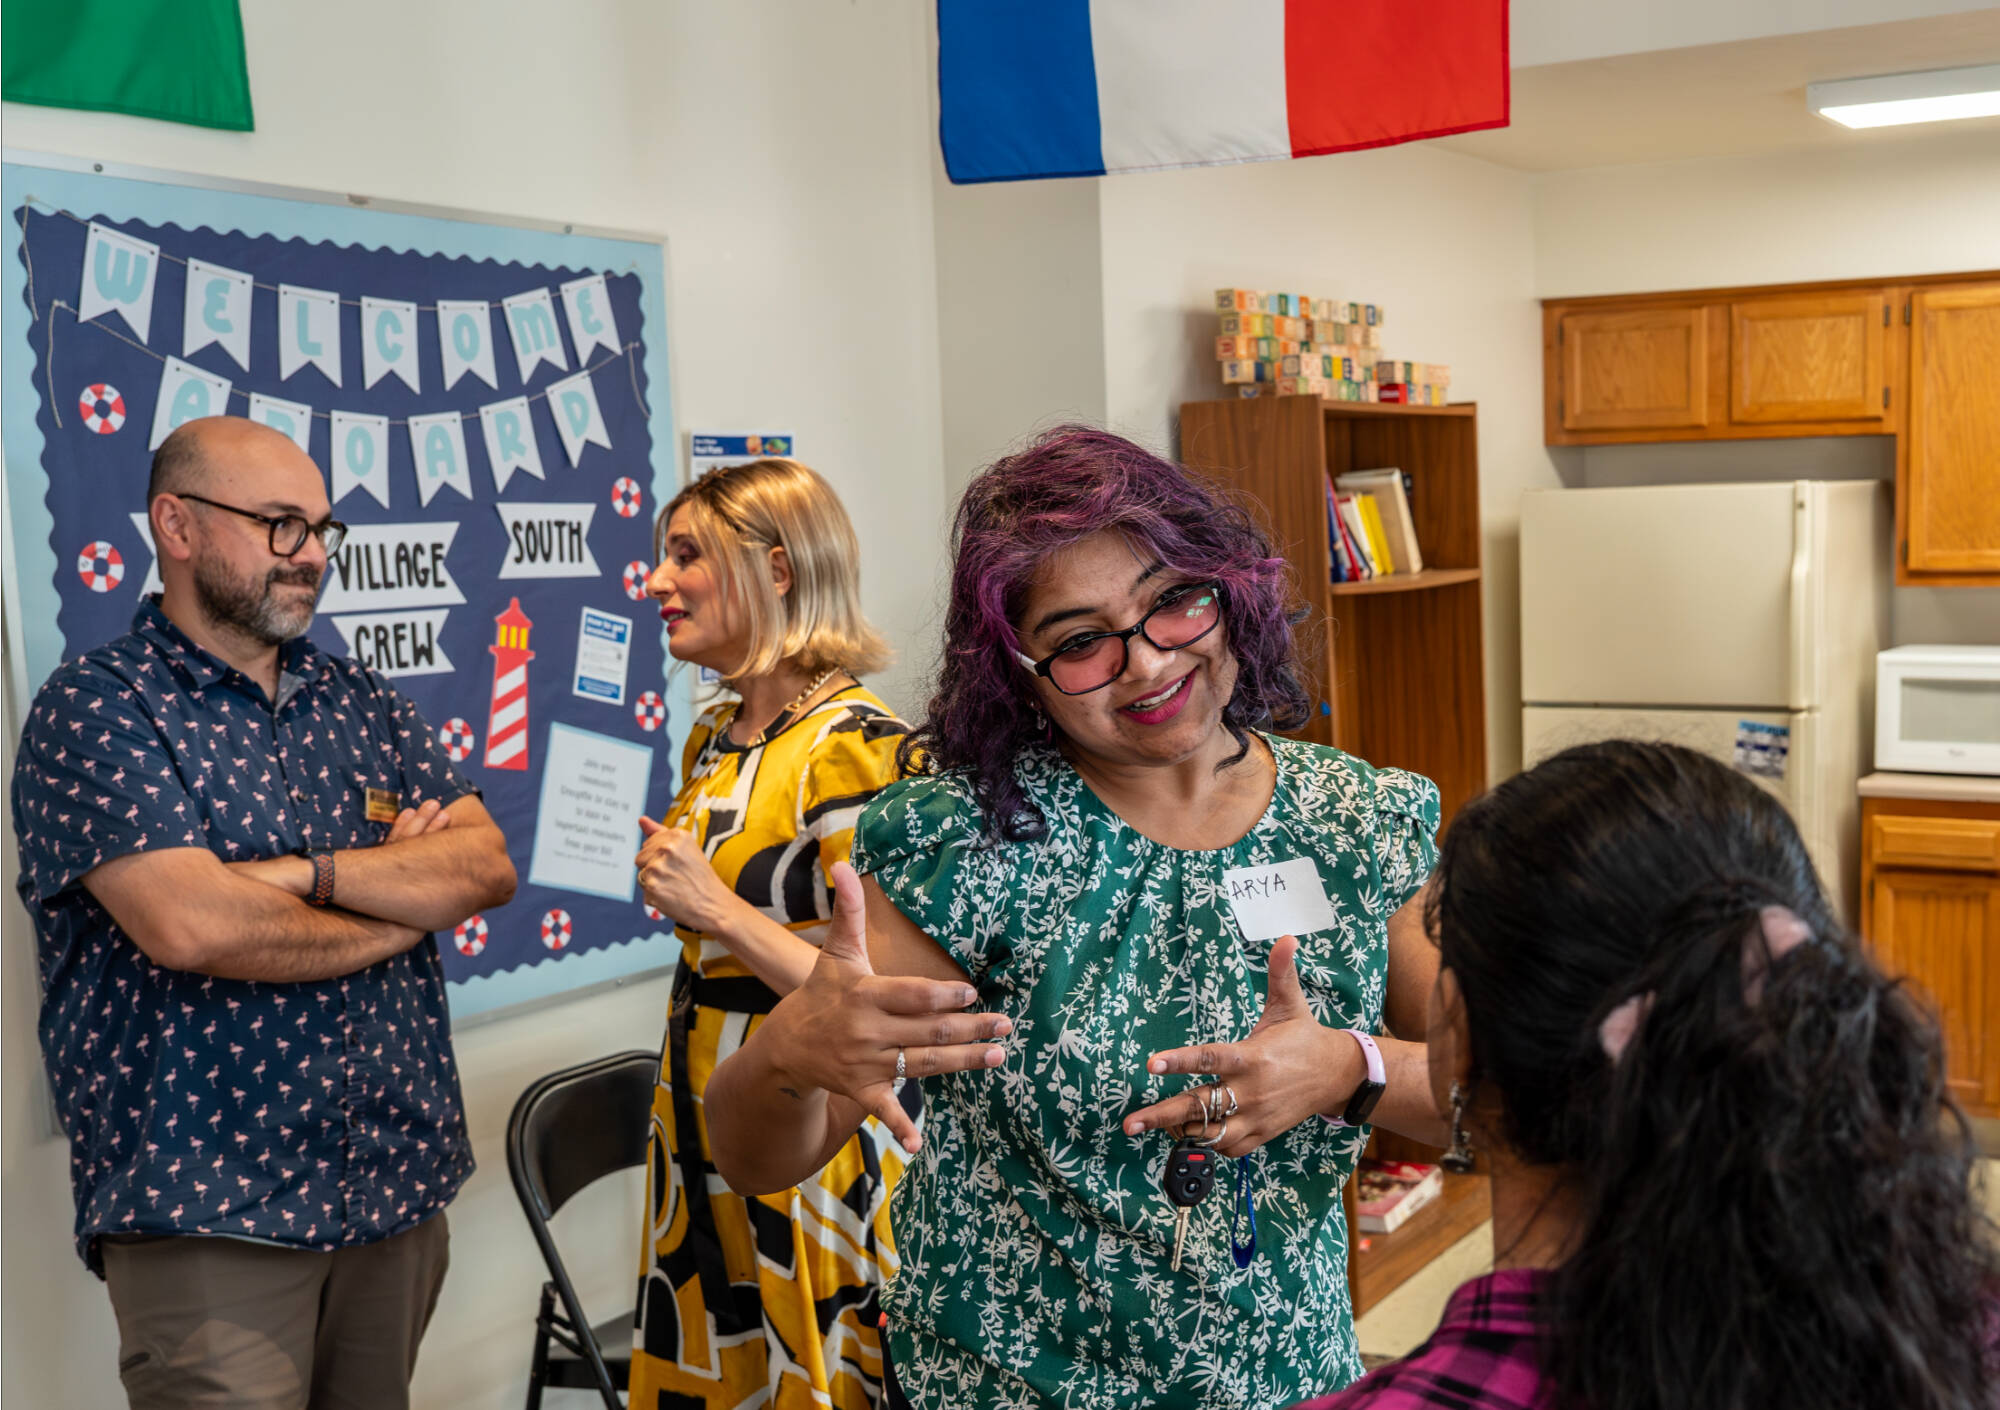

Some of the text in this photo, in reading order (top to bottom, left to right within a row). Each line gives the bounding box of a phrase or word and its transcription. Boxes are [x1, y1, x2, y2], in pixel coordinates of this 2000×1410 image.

[94, 239, 603, 363] WELCOME
[334, 541, 448, 592] VILLAGE
[511, 519, 585, 565] SOUTH
[354, 620, 435, 671] CREW
[1231, 872, 1287, 901] ARYA
